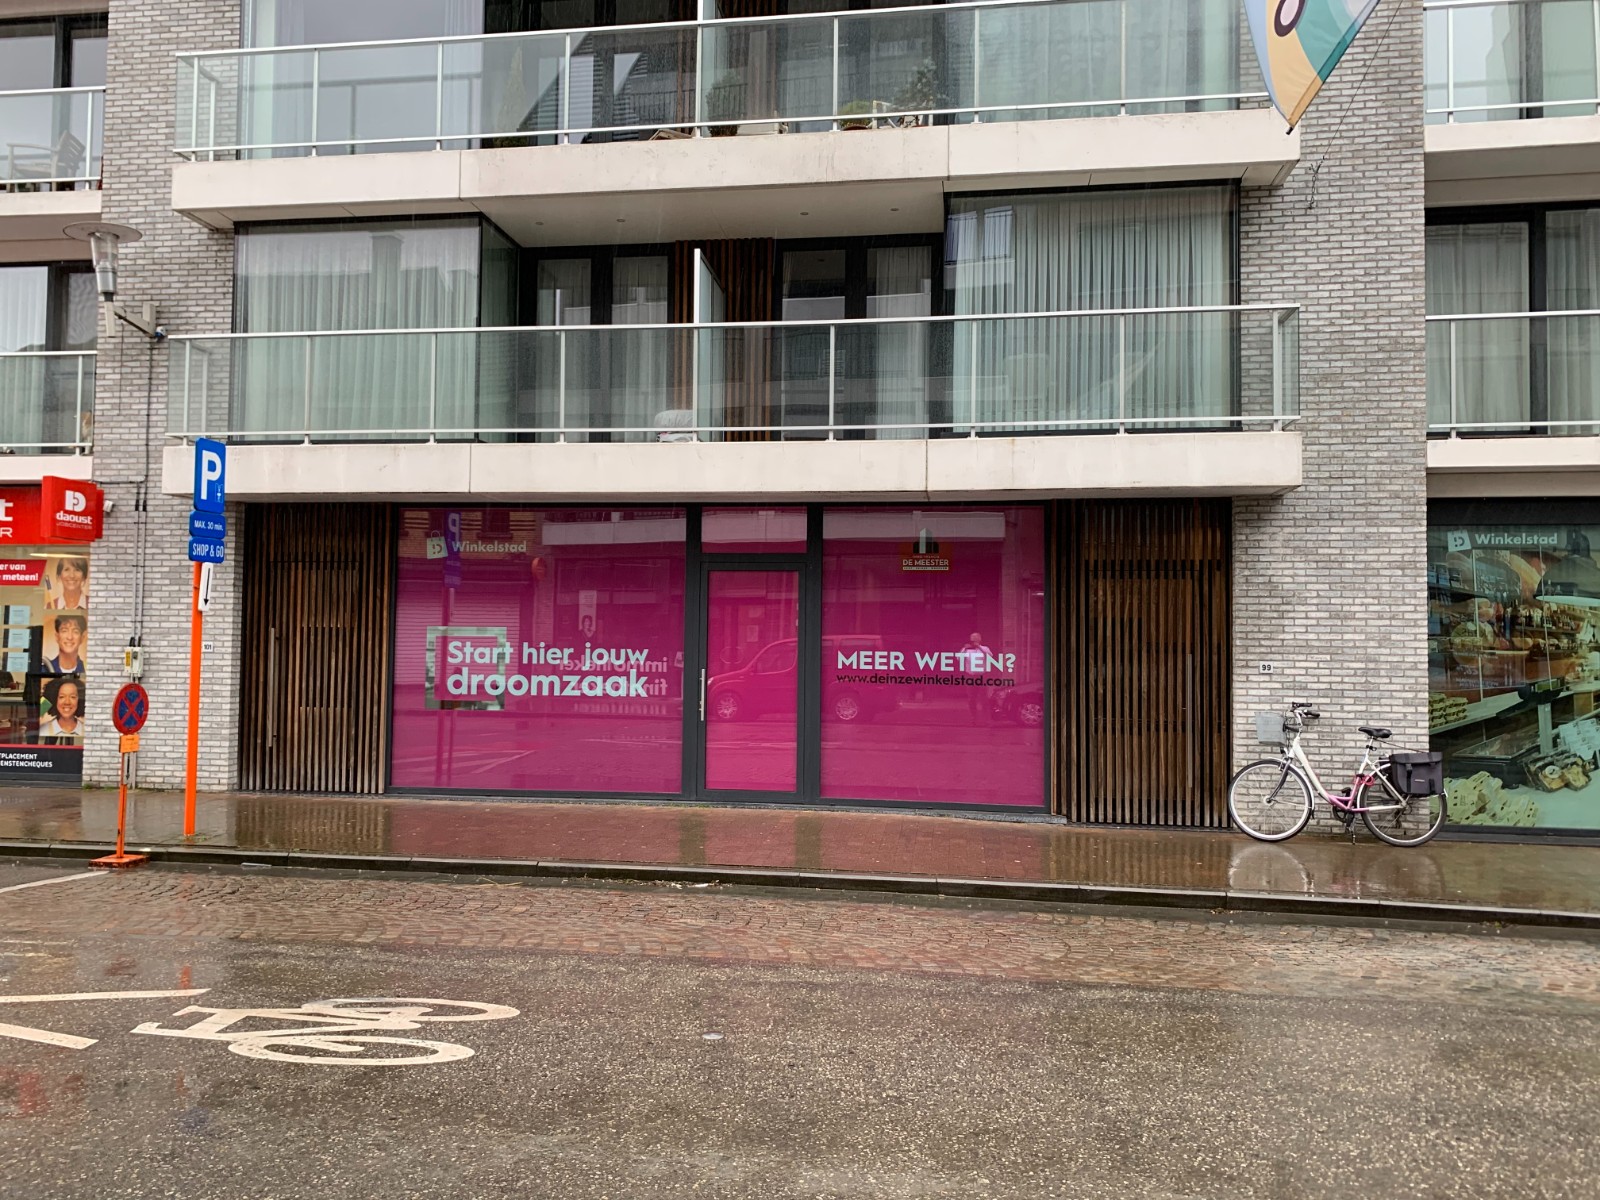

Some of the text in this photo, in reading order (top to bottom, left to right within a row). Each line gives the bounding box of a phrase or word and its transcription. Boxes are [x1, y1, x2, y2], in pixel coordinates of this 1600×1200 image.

[201, 449, 222, 500] P
[56, 511, 92, 525] daoust
[194, 520, 206, 529] MAX.
[207, 521, 214, 530] 30
[1475, 533, 1558, 545] Winkelstad
[193, 543, 224, 558] SHOP & GO
[452, 541, 526, 552] Winkelstad
[3, 573, 38, 581] meteen!
[447, 641, 649, 671] Start hier jouw
[837, 650, 1016, 673] MEER WETEN?
[447, 667, 649, 697] droomzaak
[837, 673, 1015, 687] www.deinzewinkelstad.com
[0, 752, 38, 760] PLACEMENT
